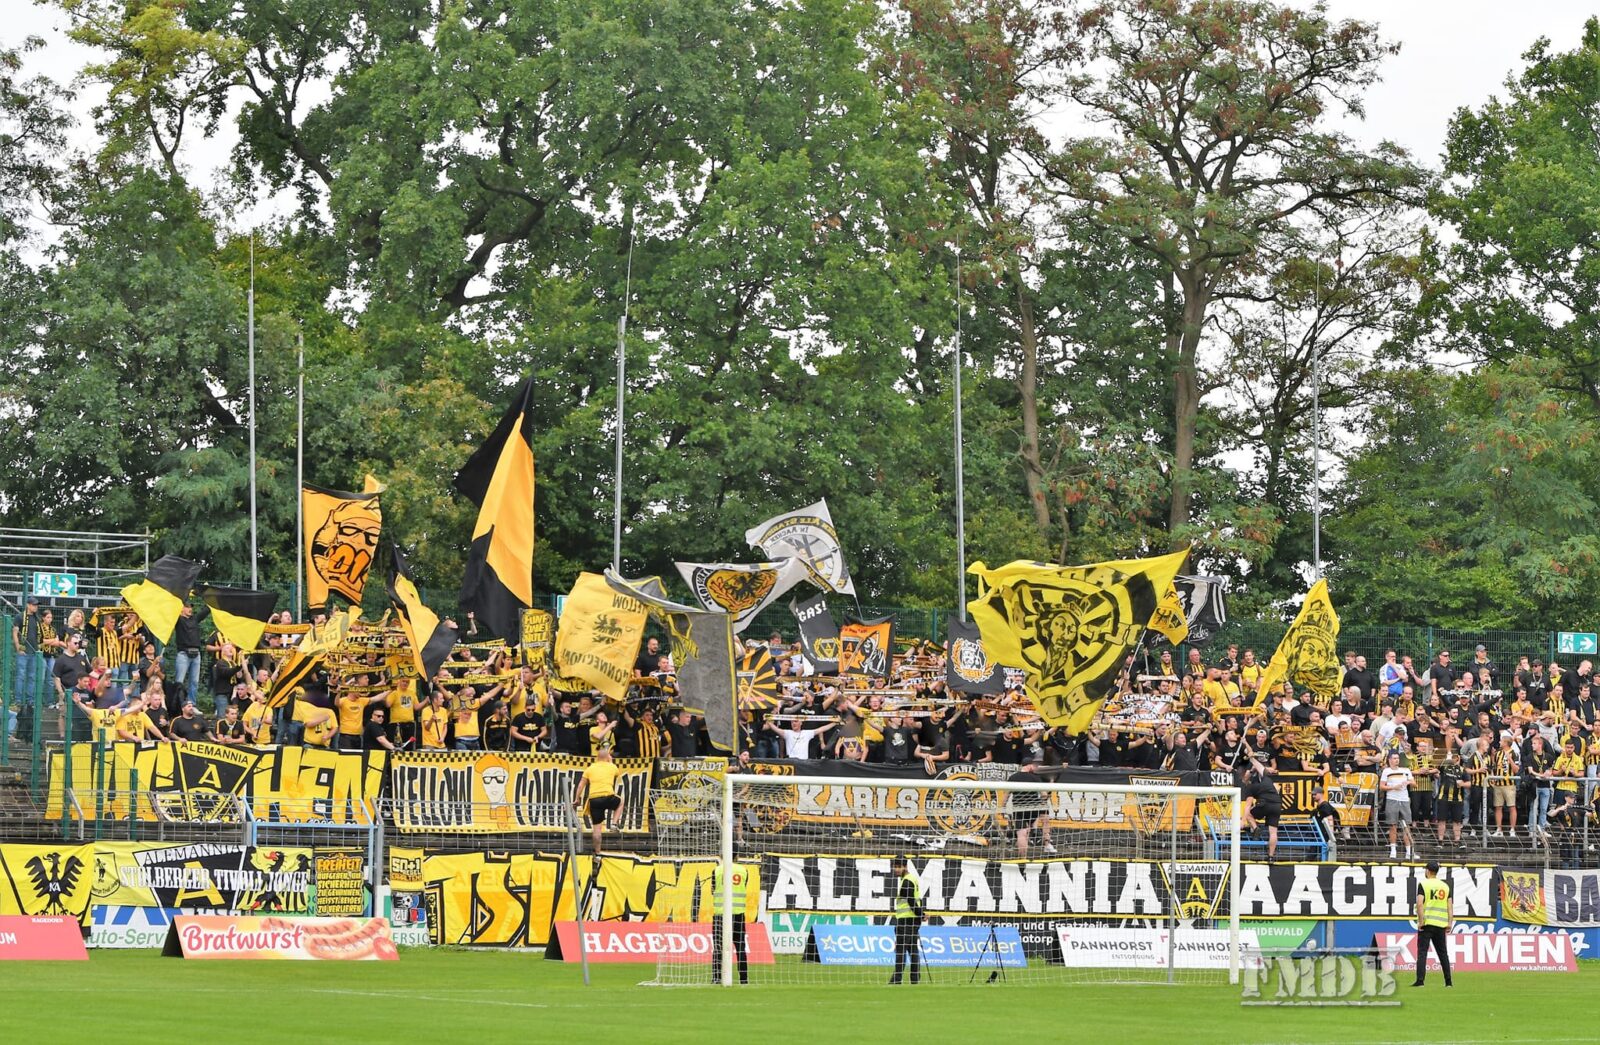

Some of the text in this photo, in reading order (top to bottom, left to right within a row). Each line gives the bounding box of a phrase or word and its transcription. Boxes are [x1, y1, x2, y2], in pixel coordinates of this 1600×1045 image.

[180, 742, 250, 770] ALEMANNIA
[687, 761, 724, 771] STADT
[514, 767, 649, 831] CONNEON
[796, 784, 920, 820] KARLS
[119, 866, 211, 890] STOLBERGER
[732, 874, 742, 886] 9
[768, 857, 1162, 913] ALEMANNIA
[1430, 888, 1446, 901] K9
[1023, 919, 1045, 930] und
[84, 928, 165, 946] uto-Serv
[182, 923, 303, 952] Bratwurst
[584, 932, 751, 954] HAGEDO
[1071, 941, 1153, 951] PANNHORST
